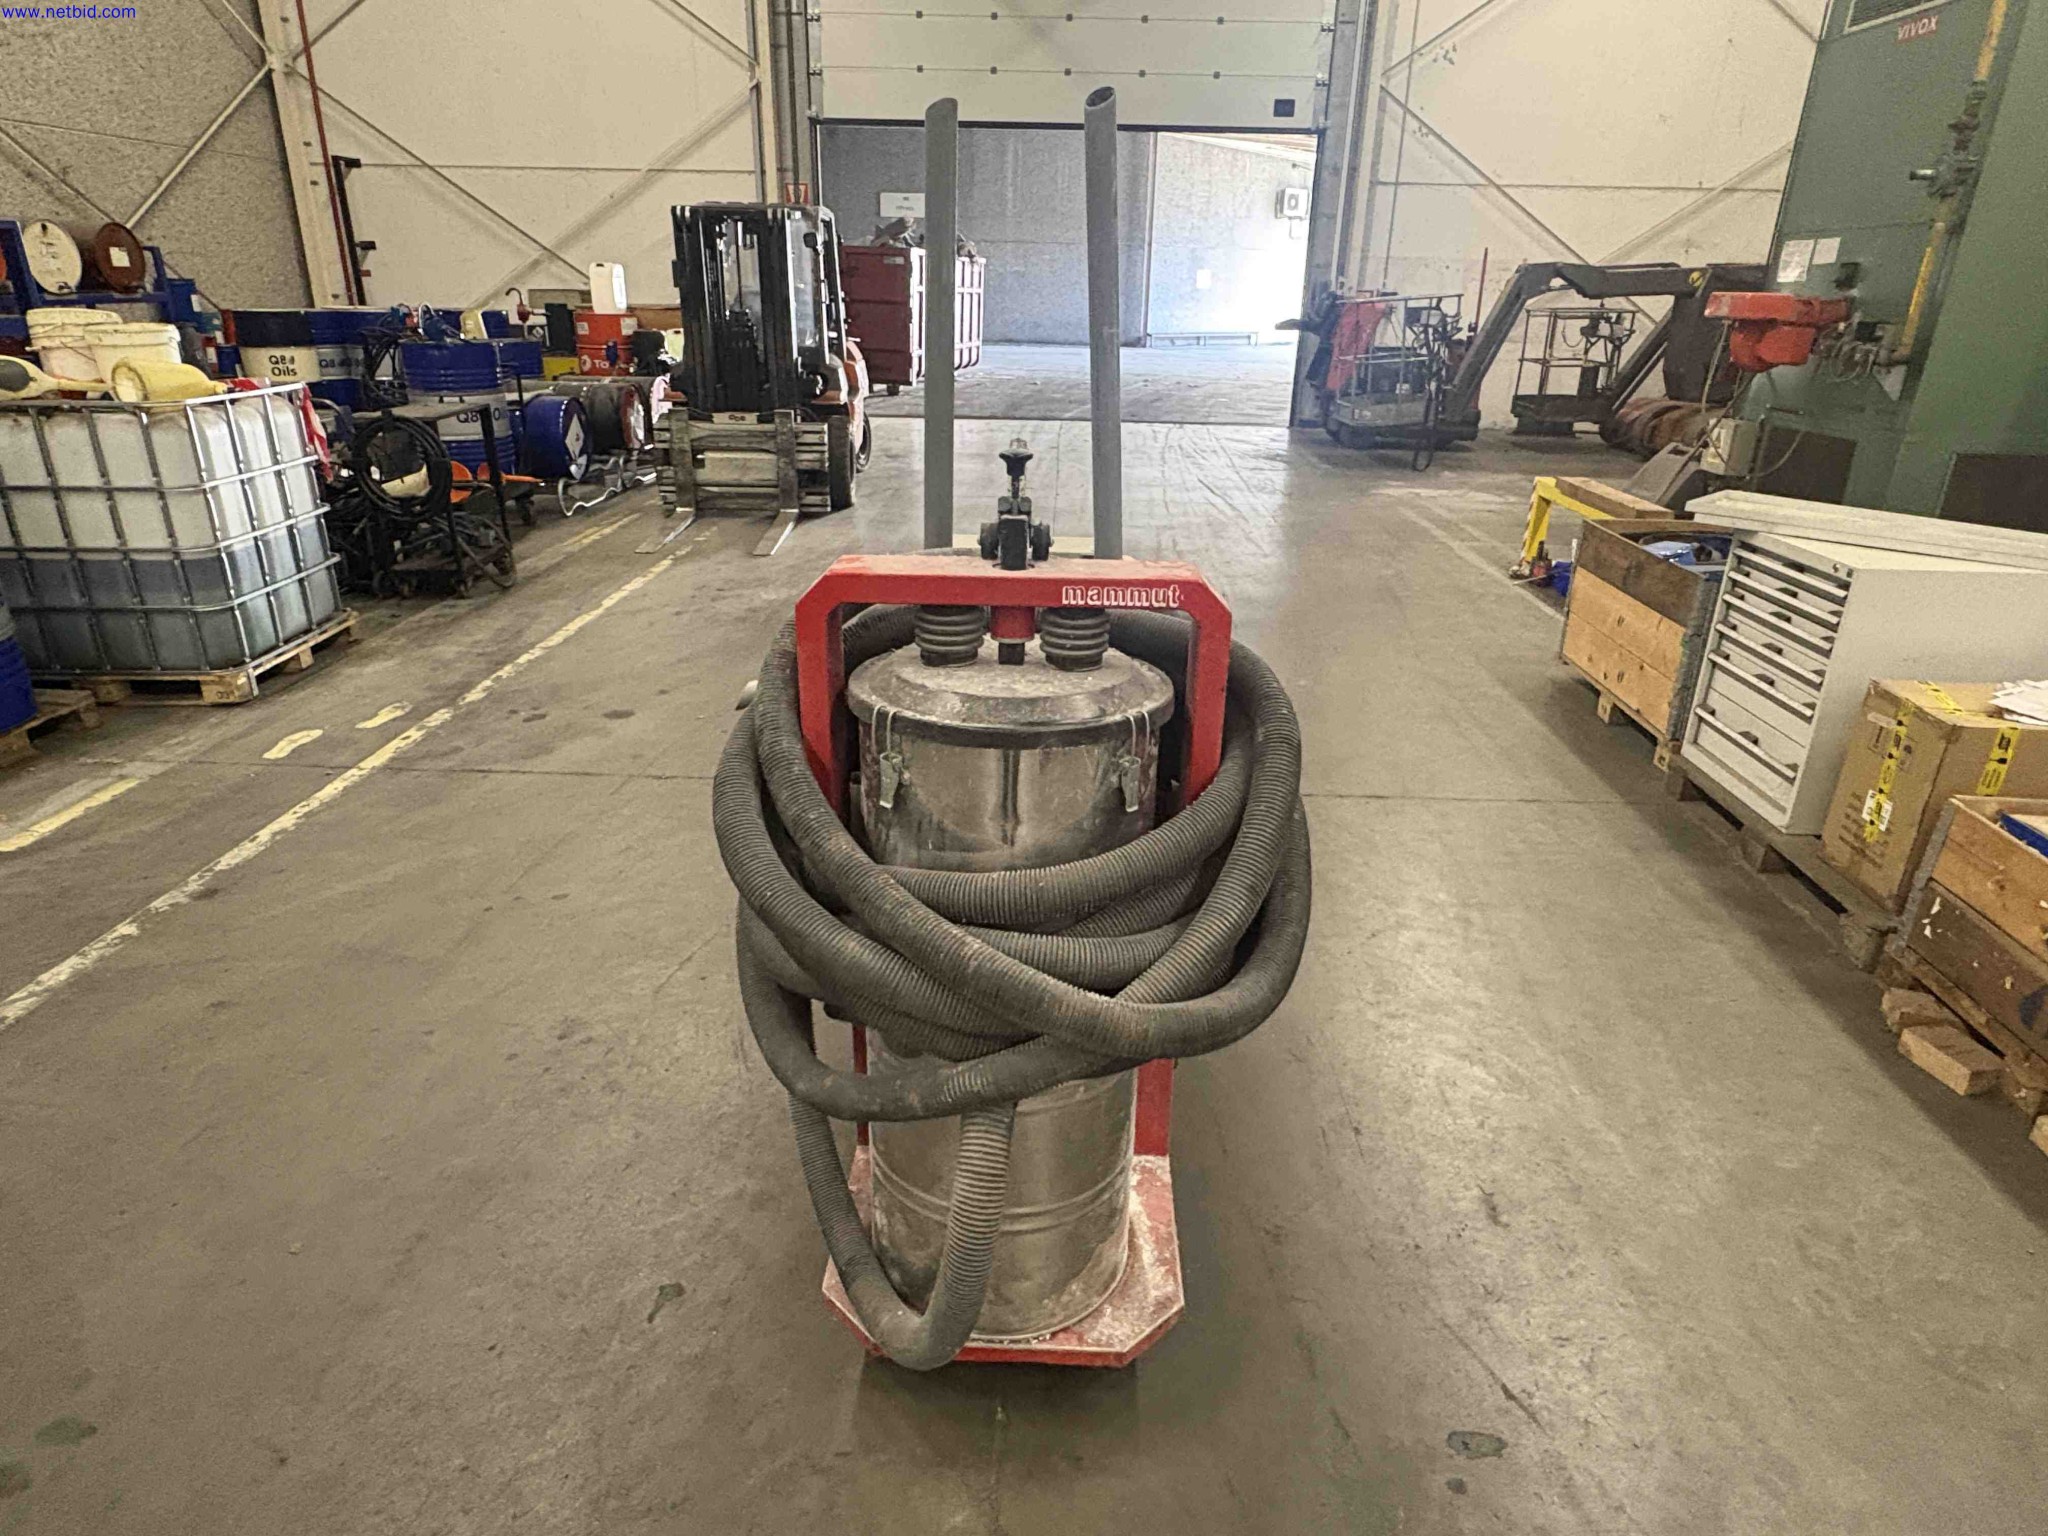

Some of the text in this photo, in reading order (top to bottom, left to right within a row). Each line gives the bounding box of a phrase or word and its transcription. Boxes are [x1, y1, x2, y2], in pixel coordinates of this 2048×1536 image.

[1898, 15, 1938, 40] VIVOX
[268, 354, 287, 365] Q8
[271, 366, 297, 376] Oils
[1062, 585, 1180, 608] mammut
